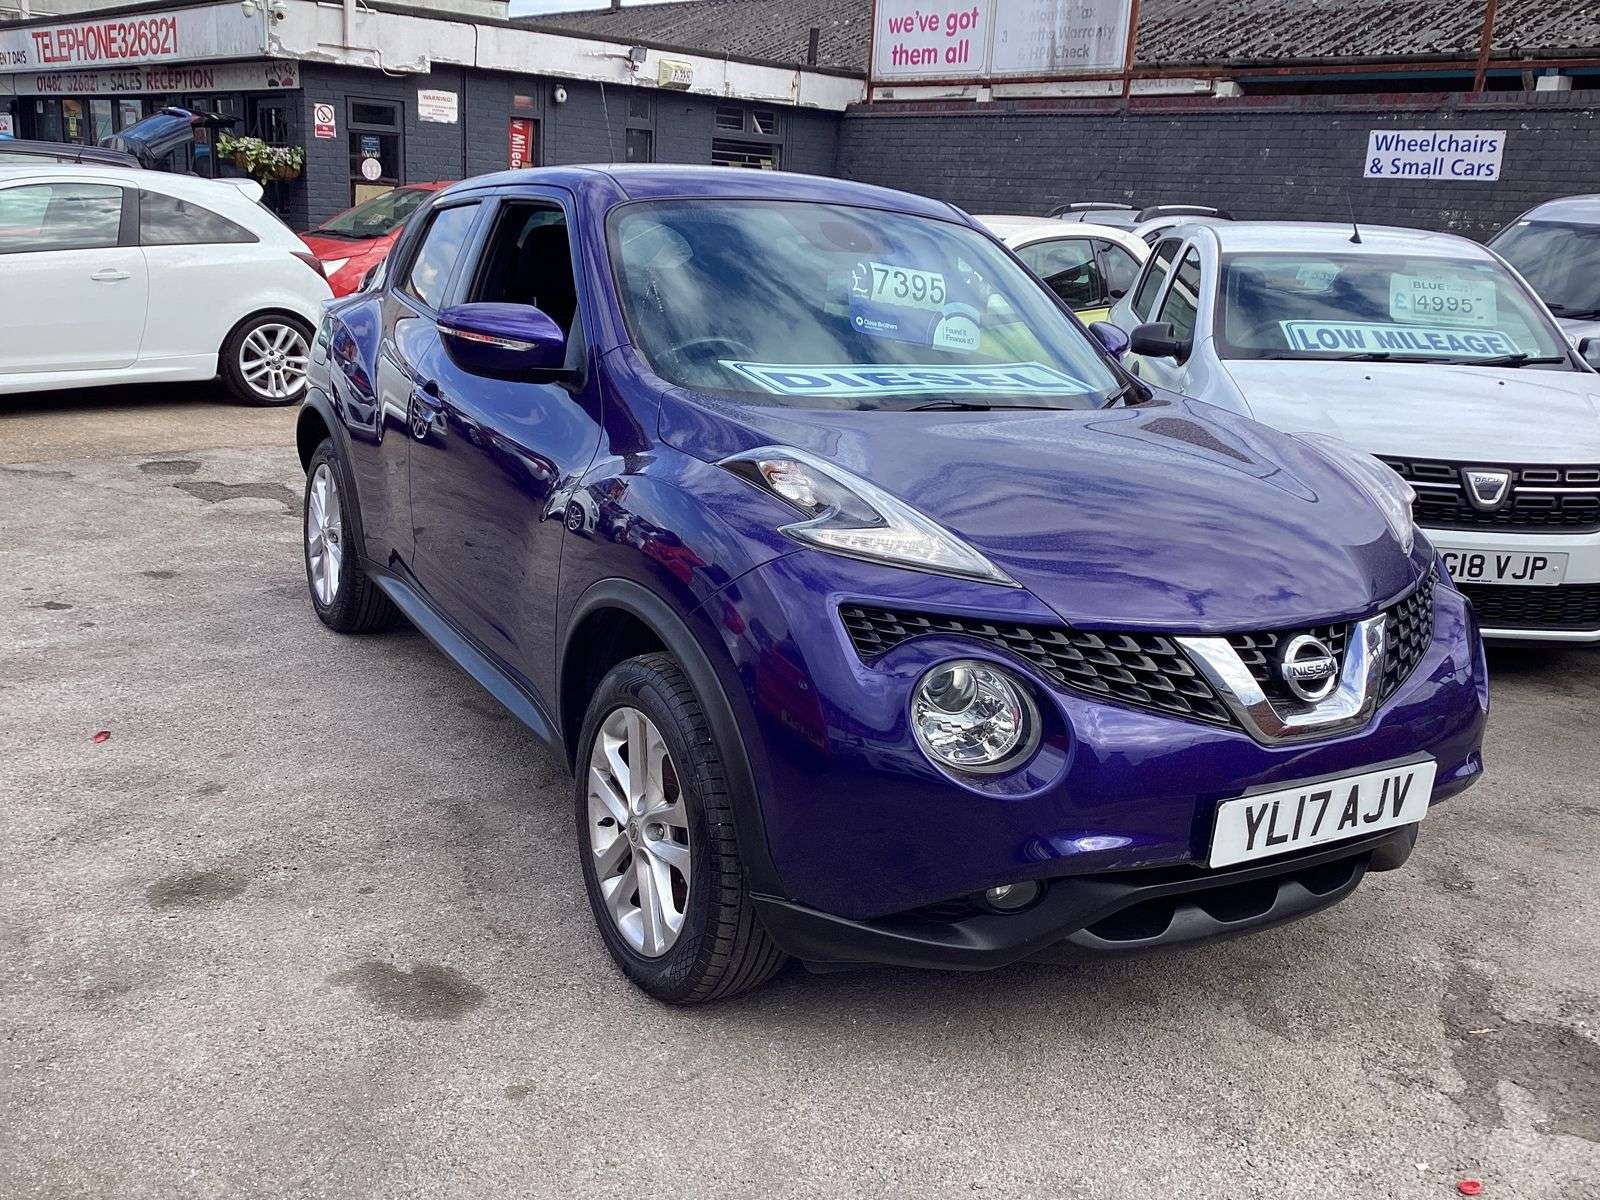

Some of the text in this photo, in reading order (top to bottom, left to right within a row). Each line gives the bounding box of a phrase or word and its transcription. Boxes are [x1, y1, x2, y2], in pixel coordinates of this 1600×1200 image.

[888, 7, 979, 37] we've got
[891, 39, 970, 66] them all
[1054, 43, 1090, 59] Check
[36, 74, 62, 92] 01482
[110, 71, 142, 91] SALES
[146, 68, 215, 90] RECEPTION
[511, 133, 526, 171] Milea
[1375, 132, 1498, 153] Wheelchairs
[1369, 157, 1495, 177] & Small Cars
[1413, 281, 1445, 291] BLUE
[1297, 328, 1510, 355] LOW MILEAGE
[762, 370, 1072, 389] DIESEL
[1442, 552, 1548, 580] G18 VJP
[1291, 661, 1336, 677] NISSAN
[1245, 772, 1415, 851] YL17 AJV
